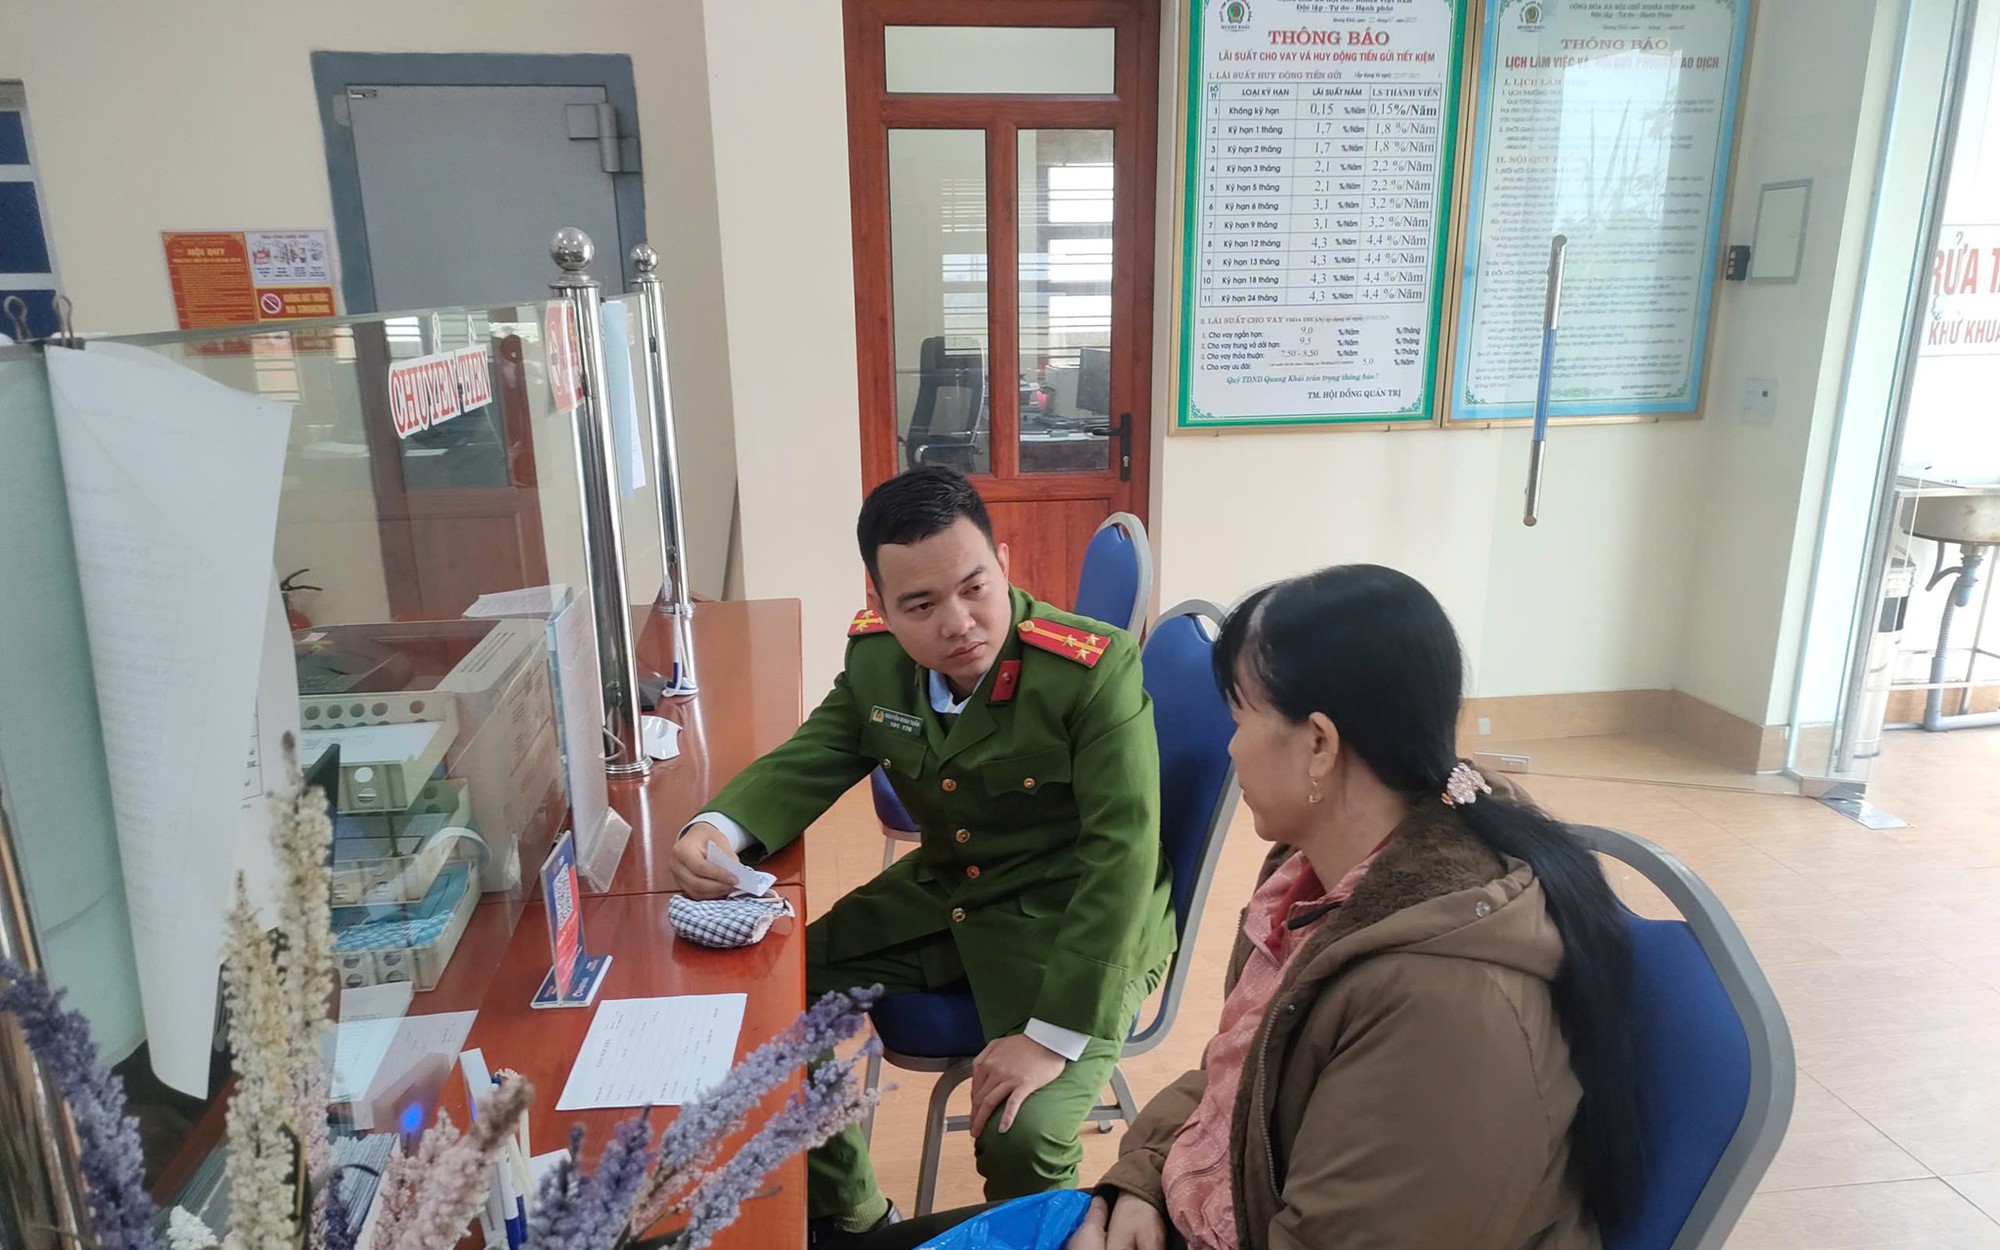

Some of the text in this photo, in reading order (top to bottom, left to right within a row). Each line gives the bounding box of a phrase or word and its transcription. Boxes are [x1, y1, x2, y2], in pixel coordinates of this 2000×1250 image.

[1268, 27, 1389, 45] THÔNG BÁO
[1560, 36, 1668, 49] THÔNG BÁO
[1219, 52, 1232, 61] LÃI
[1235, 50, 1257, 61] SUẤT
[1261, 52, 1277, 61] CHO
[1280, 52, 1297, 61] VAY
[1314, 52, 1331, 61] HUY
[1333, 50, 1357, 63] ĐỘNG
[1359, 50, 1378, 61] TIỀN
[1397, 49, 1413, 62] TIẾT
[1416, 52, 1435, 63] KIỆM
[1505, 56, 1527, 70] LỊCH
[1696, 57, 1719, 71] DỊCH
[1229, 107, 1252, 116] Không
[1265, 106, 1280, 115] hạn
[1310, 103, 1334, 115] 0,15
[1370, 103, 1437, 116] 0,15%/Năm
[1239, 126, 1254, 134] hạn
[1261, 126, 1283, 135] tháng
[1316, 123, 1331, 135] 1,7
[1376, 123, 1436, 134] 1,8 %/Năm
[1238, 145, 1252, 154] hạn
[1261, 145, 1281, 155] tháng
[1315, 142, 1330, 154] 1,7
[1375, 141, 1434, 153] 1,8 %/Năm
[1238, 164, 1252, 173] hạn
[1259, 164, 1280, 173] tháng
[1314, 161, 1330, 172] 2,1
[1372, 160, 1433, 172] 2,2 %/Năm
[1237, 183, 1251, 192] hạn
[1258, 183, 1280, 192] tháng
[1314, 180, 1330, 191] 2,1
[1371, 179, 1431, 191] 2,2 %/Năm
[1236, 202, 1250, 210] hạn
[1258, 202, 1279, 210] tháng
[1313, 198, 1328, 210] 3,1
[1370, 198, 1429, 210] 3,2 %/Năm
[1235, 220, 1249, 229] hạn
[1257, 220, 1277, 229] tháng
[1313, 218, 1328, 229] 3,1
[1368, 216, 1428, 228] 3,2 %/Năm
[1234, 239, 1249, 248] hạn
[1251, 239, 1259, 247] 12
[1260, 239, 1280, 248] tháng
[1311, 237, 1327, 249] 4,3
[1367, 234, 1426, 246] 4,4 %/Năm
[1233, 258, 1248, 266] hạn
[1259, 257, 1280, 267] tháng
[1311, 255, 1327, 267] 4,3
[1365, 253, 1424, 265] 4,4 %/Năm
[1932, 232, 1979, 295] RỬA
[1233, 276, 1247, 284] hạn
[1258, 276, 1279, 285] tháng
[1310, 273, 1326, 285] 4,3
[1364, 271, 1423, 284] 4,4 %/Năm
[1232, 294, 1246, 303] hạn
[1257, 294, 1278, 303] tháng
[1309, 291, 1325, 303] 4,3
[1362, 289, 1422, 301] 4,4 %/Năm
[1308, 388, 1401, 400] TM. HỘI ĐỒNG QUẢN TRỊ
